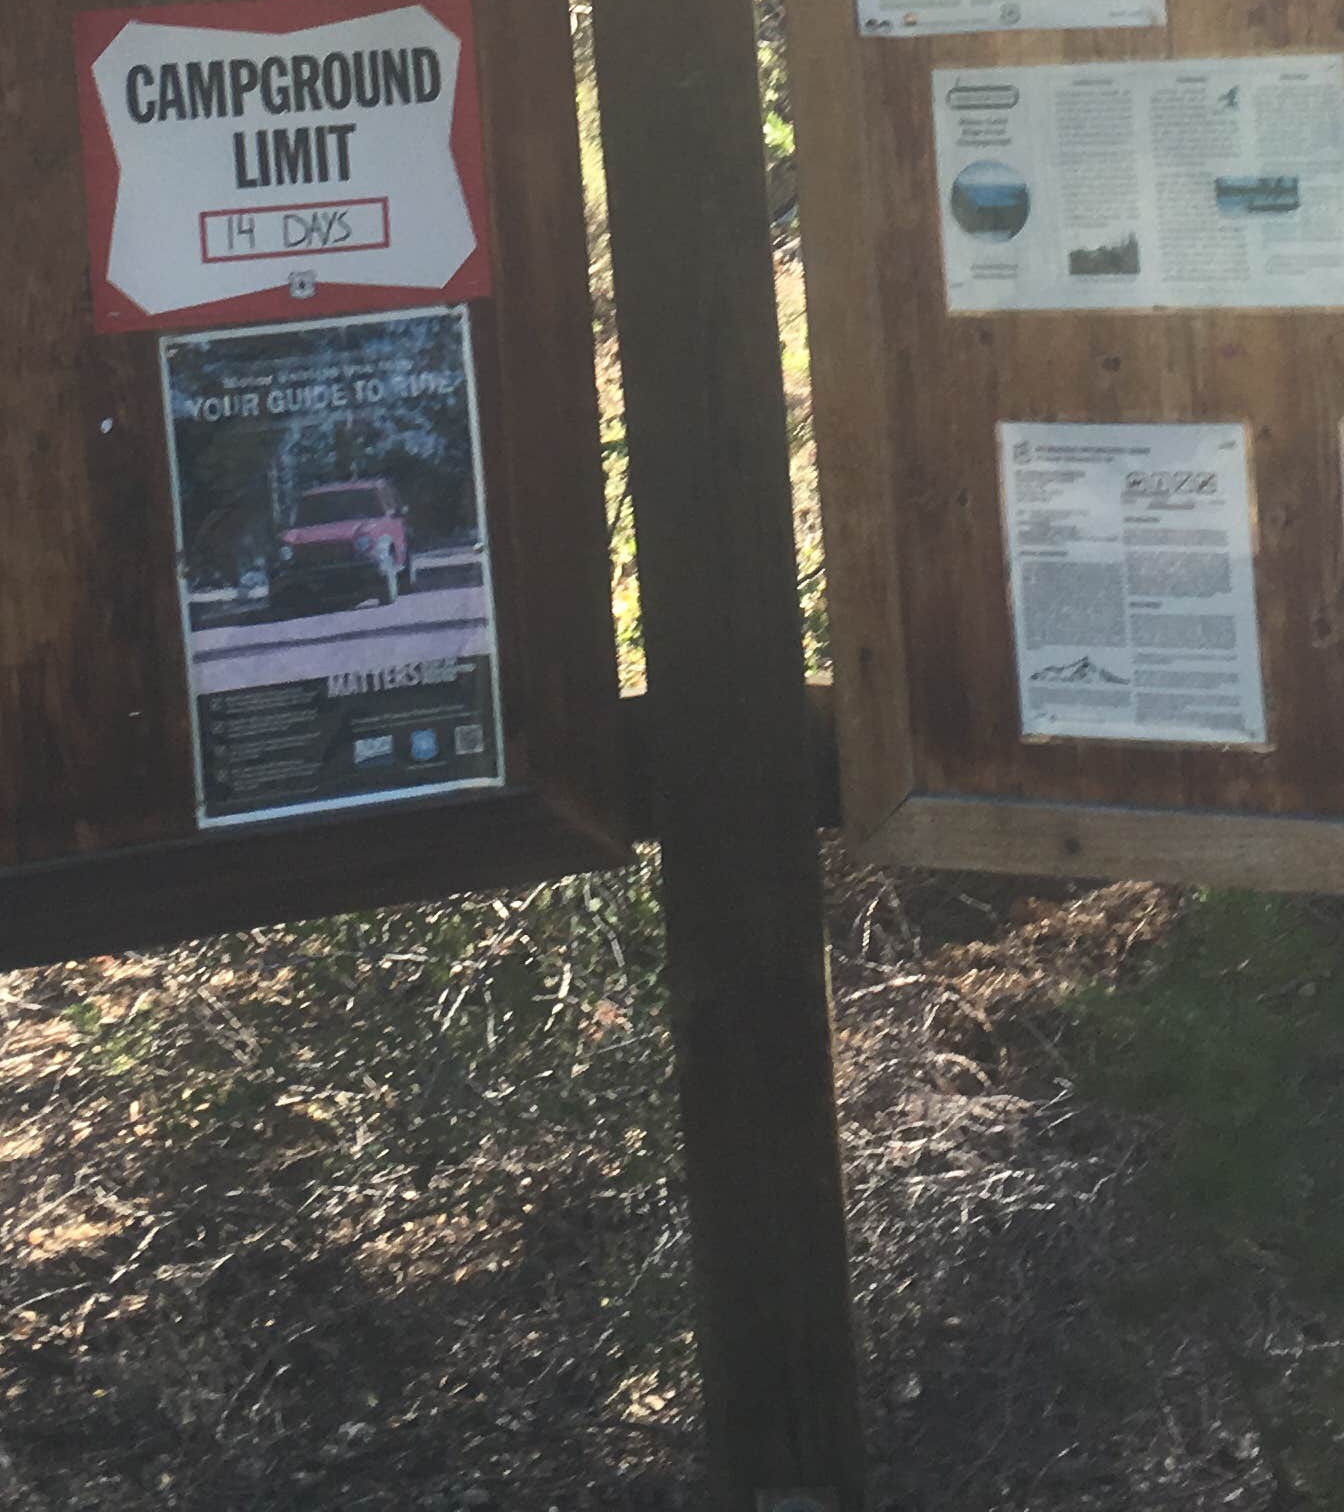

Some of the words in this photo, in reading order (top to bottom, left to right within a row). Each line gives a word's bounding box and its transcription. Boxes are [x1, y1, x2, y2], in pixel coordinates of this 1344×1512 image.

[125, 46, 442, 124] CAMPGROUND
[231, 122, 357, 190] LIMIT
[227, 214, 255, 250] 14
[283, 210, 353, 248] DAYS
[186, 393, 260, 422] YOUR
[266, 383, 348, 414] GUIDE
[354, 378, 385, 404] TO
